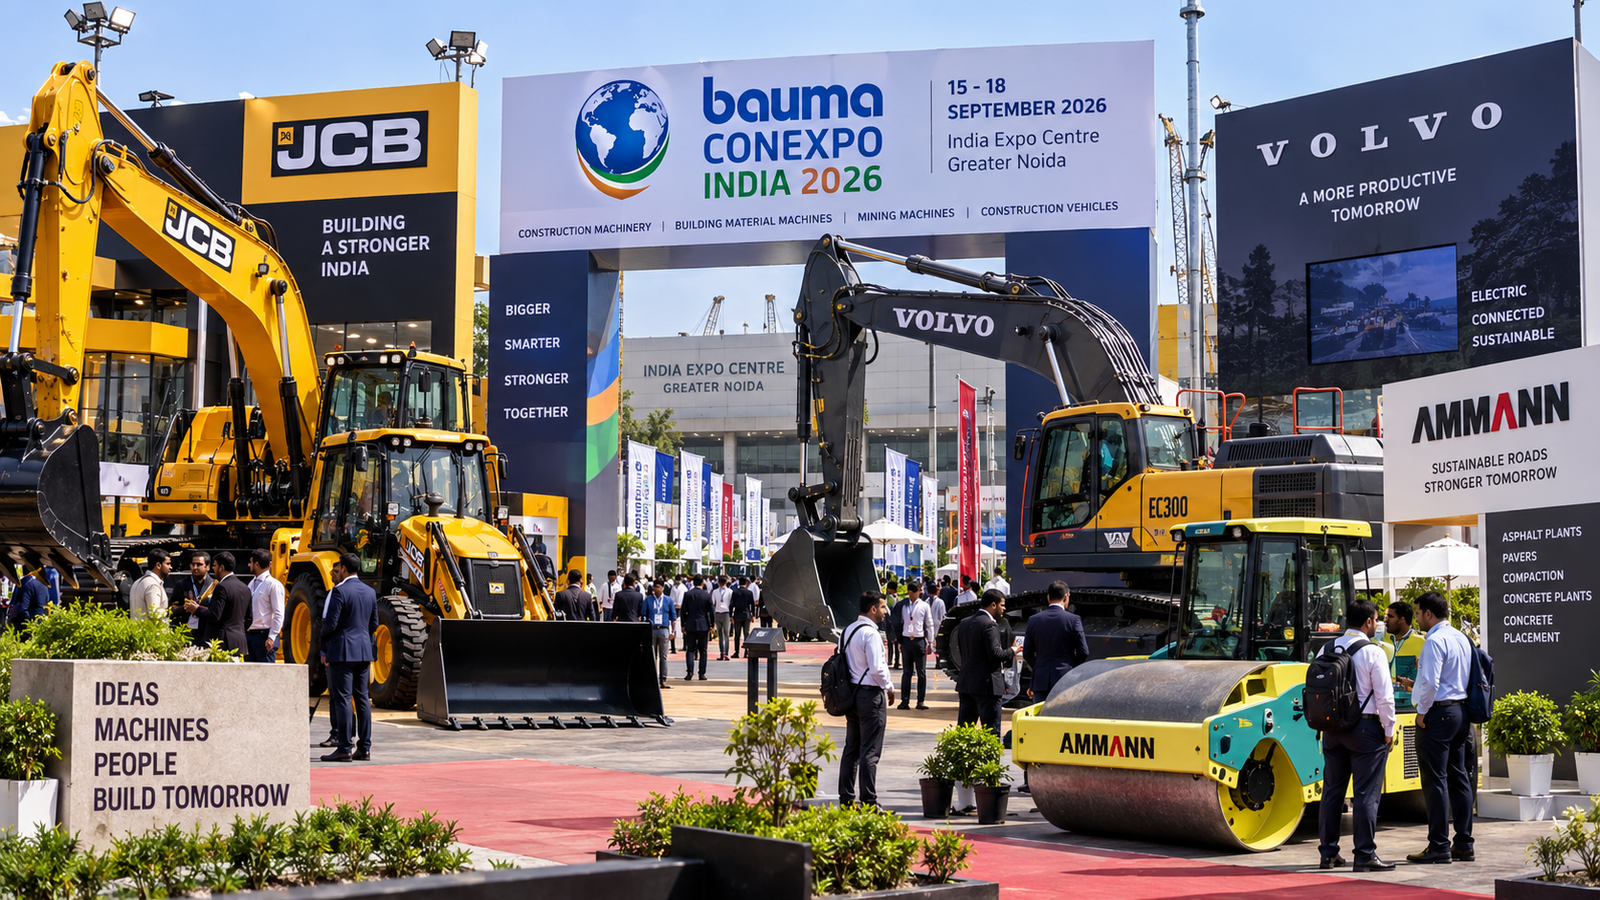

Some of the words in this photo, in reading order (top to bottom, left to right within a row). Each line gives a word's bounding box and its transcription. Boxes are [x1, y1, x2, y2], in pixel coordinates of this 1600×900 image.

[948, 80, 967, 95] 15
[986, 78, 1005, 93] 18
[703, 77, 883, 124] bauma
[948, 101, 1055, 119] SEPTEMBER
[1062, 98, 1106, 114] 2026
[949, 133, 988, 148] India
[996, 132, 1036, 150] Expo
[1043, 130, 1099, 145] Centre
[1257, 101, 1503, 166] VOLVO
[277, 117, 422, 170] JCB
[704, 126, 882, 164] CONEXPO
[949, 157, 1011, 172] Greater
[1018, 153, 1065, 169] Noida
[705, 170, 791, 199] INDIA
[802, 165, 882, 194] 2026
[1299, 193, 1308, 205] A
[1314, 185, 1354, 203] MORE
[1360, 168, 1456, 196] PRODUCTIVE
[858, 211, 896, 221] MINING
[900, 208, 954, 219] MACHINES
[981, 204, 1063, 216] CONSTRUCTION
[1067, 201, 1118, 212] VEHICLES
[1332, 196, 1421, 222] TOMORROW
[323, 215, 405, 233] BUILDING
[519, 226, 591, 238] CONSTRUCTION
[595, 223, 651, 234] MACHINERY
[676, 219, 722, 230] BUILDING
[726, 217, 775, 227] MATERIAL
[779, 214, 832, 224] MACHINES
[165, 209, 232, 269] JCB
[322, 241, 333, 255] A
[338, 236, 429, 254] STRONGER
[322, 261, 369, 276] INDIA
[1472, 285, 1527, 302] ELECTRIC
[506, 303, 550, 315] BIGGER
[1472, 307, 1544, 325] CONNECTED
[893, 306, 995, 338] VOLVO
[505, 337, 560, 350] SMARTER
[1473, 328, 1554, 347] SUSTAINABLE
[644, 364, 681, 377] INDIA
[687, 363, 723, 375] EXPO
[729, 361, 784, 374] CENTRE
[505, 373, 568, 386] STRONGER
[664, 382, 718, 393] GREATER
[725, 381, 764, 391] NOIDA
[504, 406, 568, 419] TOGETHER
[1412, 382, 1569, 444] AMMANN
[1432, 453, 1505, 475] SUSTAINABLE
[1508, 448, 1547, 464] ROADS
[1425, 476, 1482, 493] STRONGER
[1486, 466, 1558, 487] TOMORROW
[1149, 496, 1187, 518] EC300
[1502, 530, 1543, 542] ASPHALT
[1546, 526, 1581, 538] PLANTS
[1503, 551, 1537, 562] PAVERS
[1503, 570, 1563, 583] COMPACTION
[1504, 592, 1552, 603] CONCRETE
[1555, 591, 1592, 601] PLANTS
[1504, 615, 1553, 625] CONCRETE
[1504, 632, 1560, 643] PLACEMENT
[96, 682, 158, 706] IDEAS
[95, 718, 209, 741] MACHINES
[1060, 733, 1154, 759] AMMANN
[95, 752, 177, 776] PEOPLE
[94, 787, 155, 811] BUILD
[162, 784, 289, 809] TOMORROW
